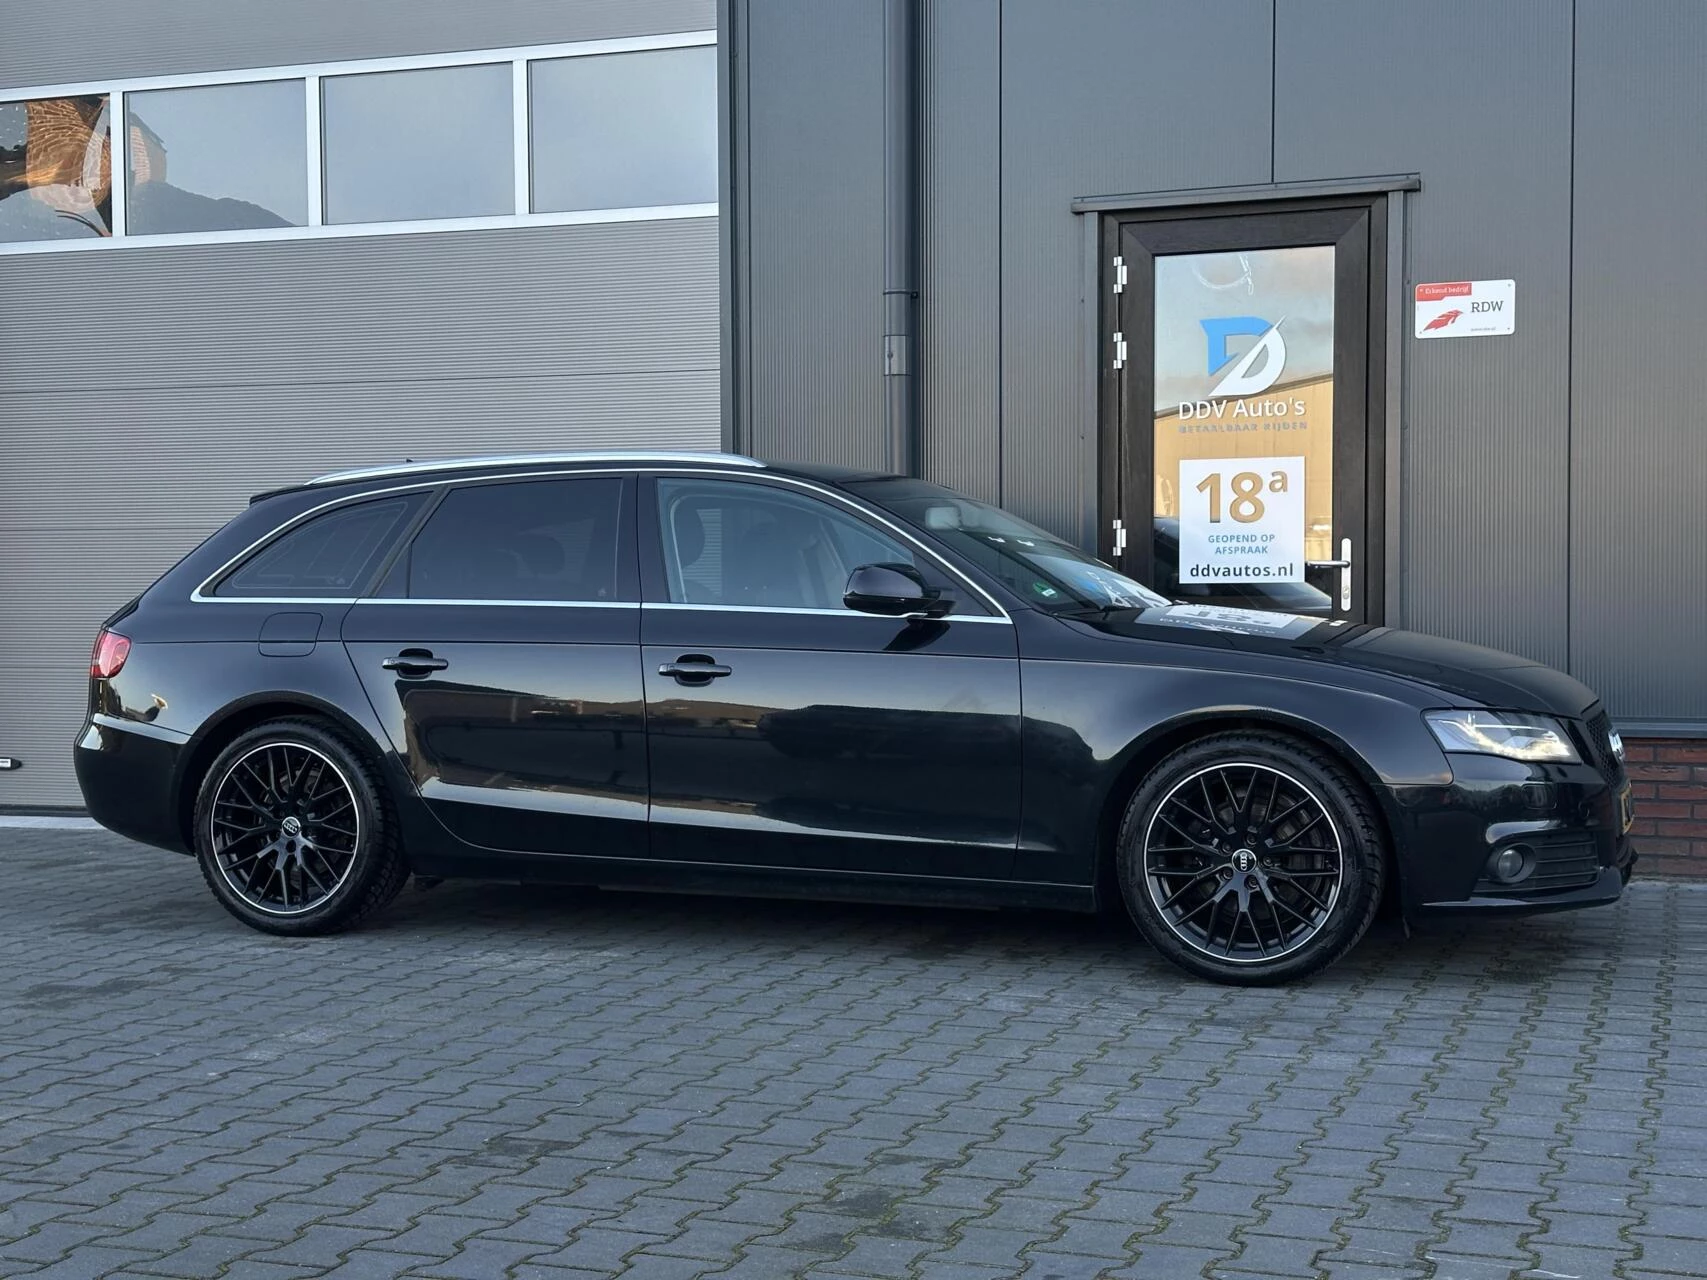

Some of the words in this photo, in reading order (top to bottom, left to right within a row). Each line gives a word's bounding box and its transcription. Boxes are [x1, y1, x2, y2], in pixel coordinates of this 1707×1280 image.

[1471, 300, 1504, 313] RDW
[1179, 399, 1227, 420] DDV
[1232, 397, 1306, 418] Auto's
[1264, 421, 1308, 431] RIJDEN
[1208, 534, 1257, 543] GEOPEND
[1260, 534, 1275, 543] OP
[1214, 546, 1268, 555] AFSPRAAK
[1190, 563, 1294, 577] ddvautos.nl
